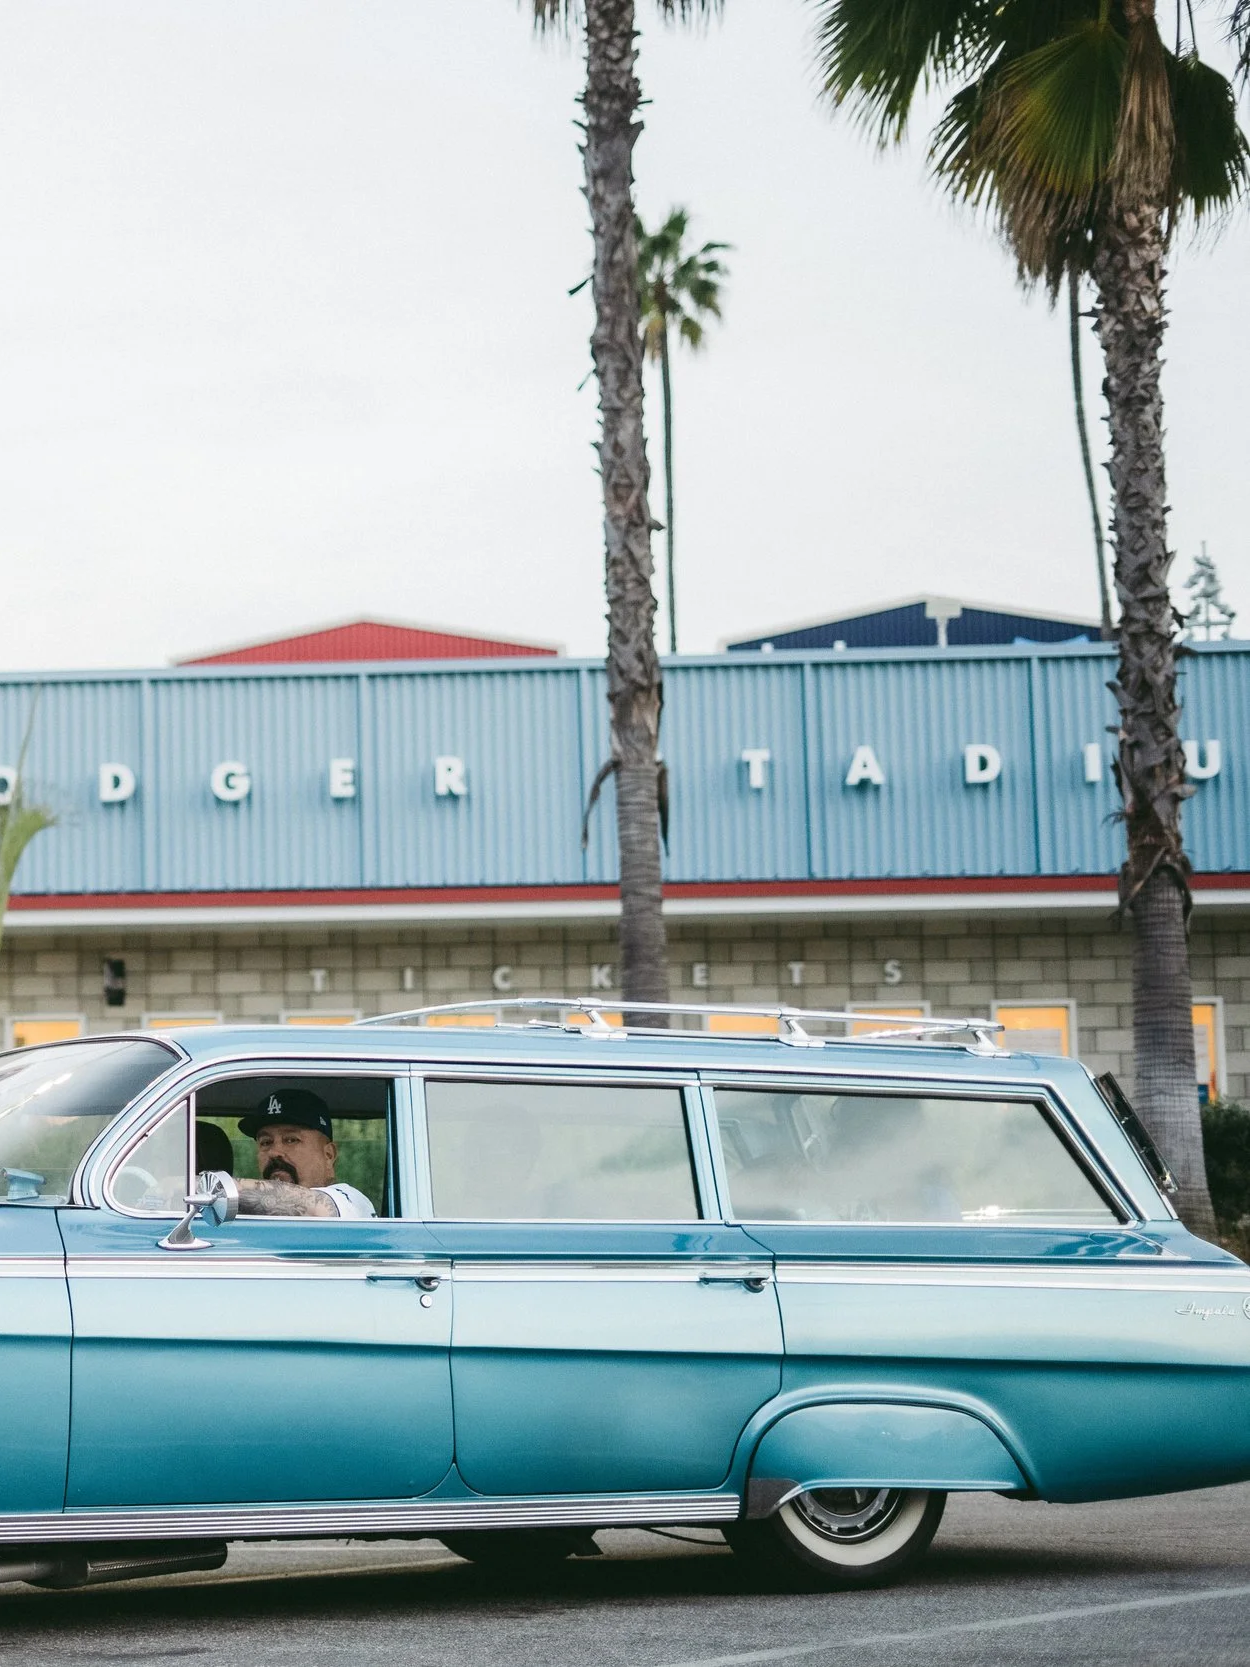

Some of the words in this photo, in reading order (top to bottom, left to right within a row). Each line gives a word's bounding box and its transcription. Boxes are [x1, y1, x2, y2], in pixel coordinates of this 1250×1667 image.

[654, 739, 1221, 789] TADIU
[309, 960, 901, 992] TICKETS
[267, 1094, 282, 1115] LA
[1175, 1301, 1236, 1320] Impala
